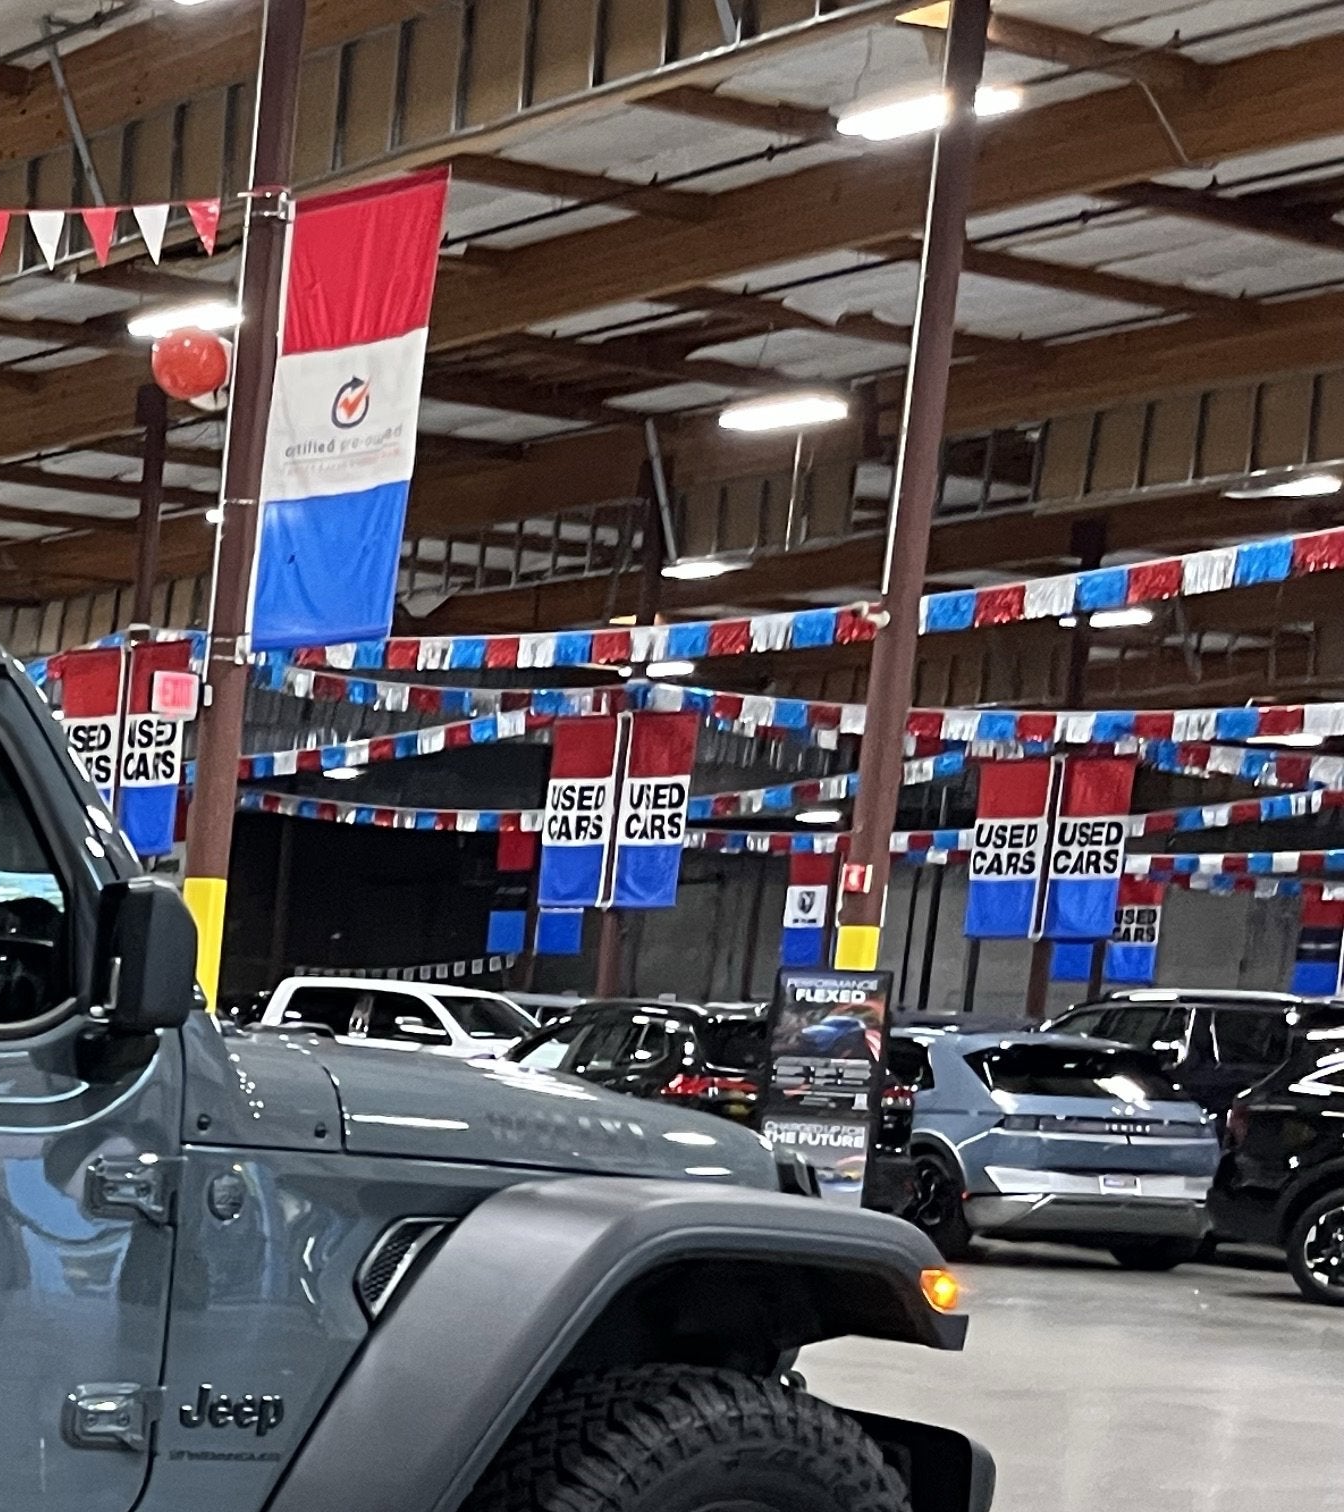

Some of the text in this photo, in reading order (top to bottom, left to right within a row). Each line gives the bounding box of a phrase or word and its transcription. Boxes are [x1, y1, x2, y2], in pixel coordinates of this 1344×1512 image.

[68, 723, 112, 753] SED
[551, 785, 606, 811] USED
[629, 783, 686, 810] USED
[547, 814, 603, 840] CARS
[624, 812, 683, 840] CARS
[975, 823, 1039, 849] USED
[1057, 821, 1124, 847] USED
[972, 850, 1036, 875] CARS
[1053, 849, 1119, 875] CARS
[1114, 908, 1158, 925] USED
[1112, 925, 1156, 942] CARS
[795, 988, 867, 1003] FLEXED
[764, 1129, 865, 1148] THE FUTURE
[179, 1383, 284, 1436] Jeep
